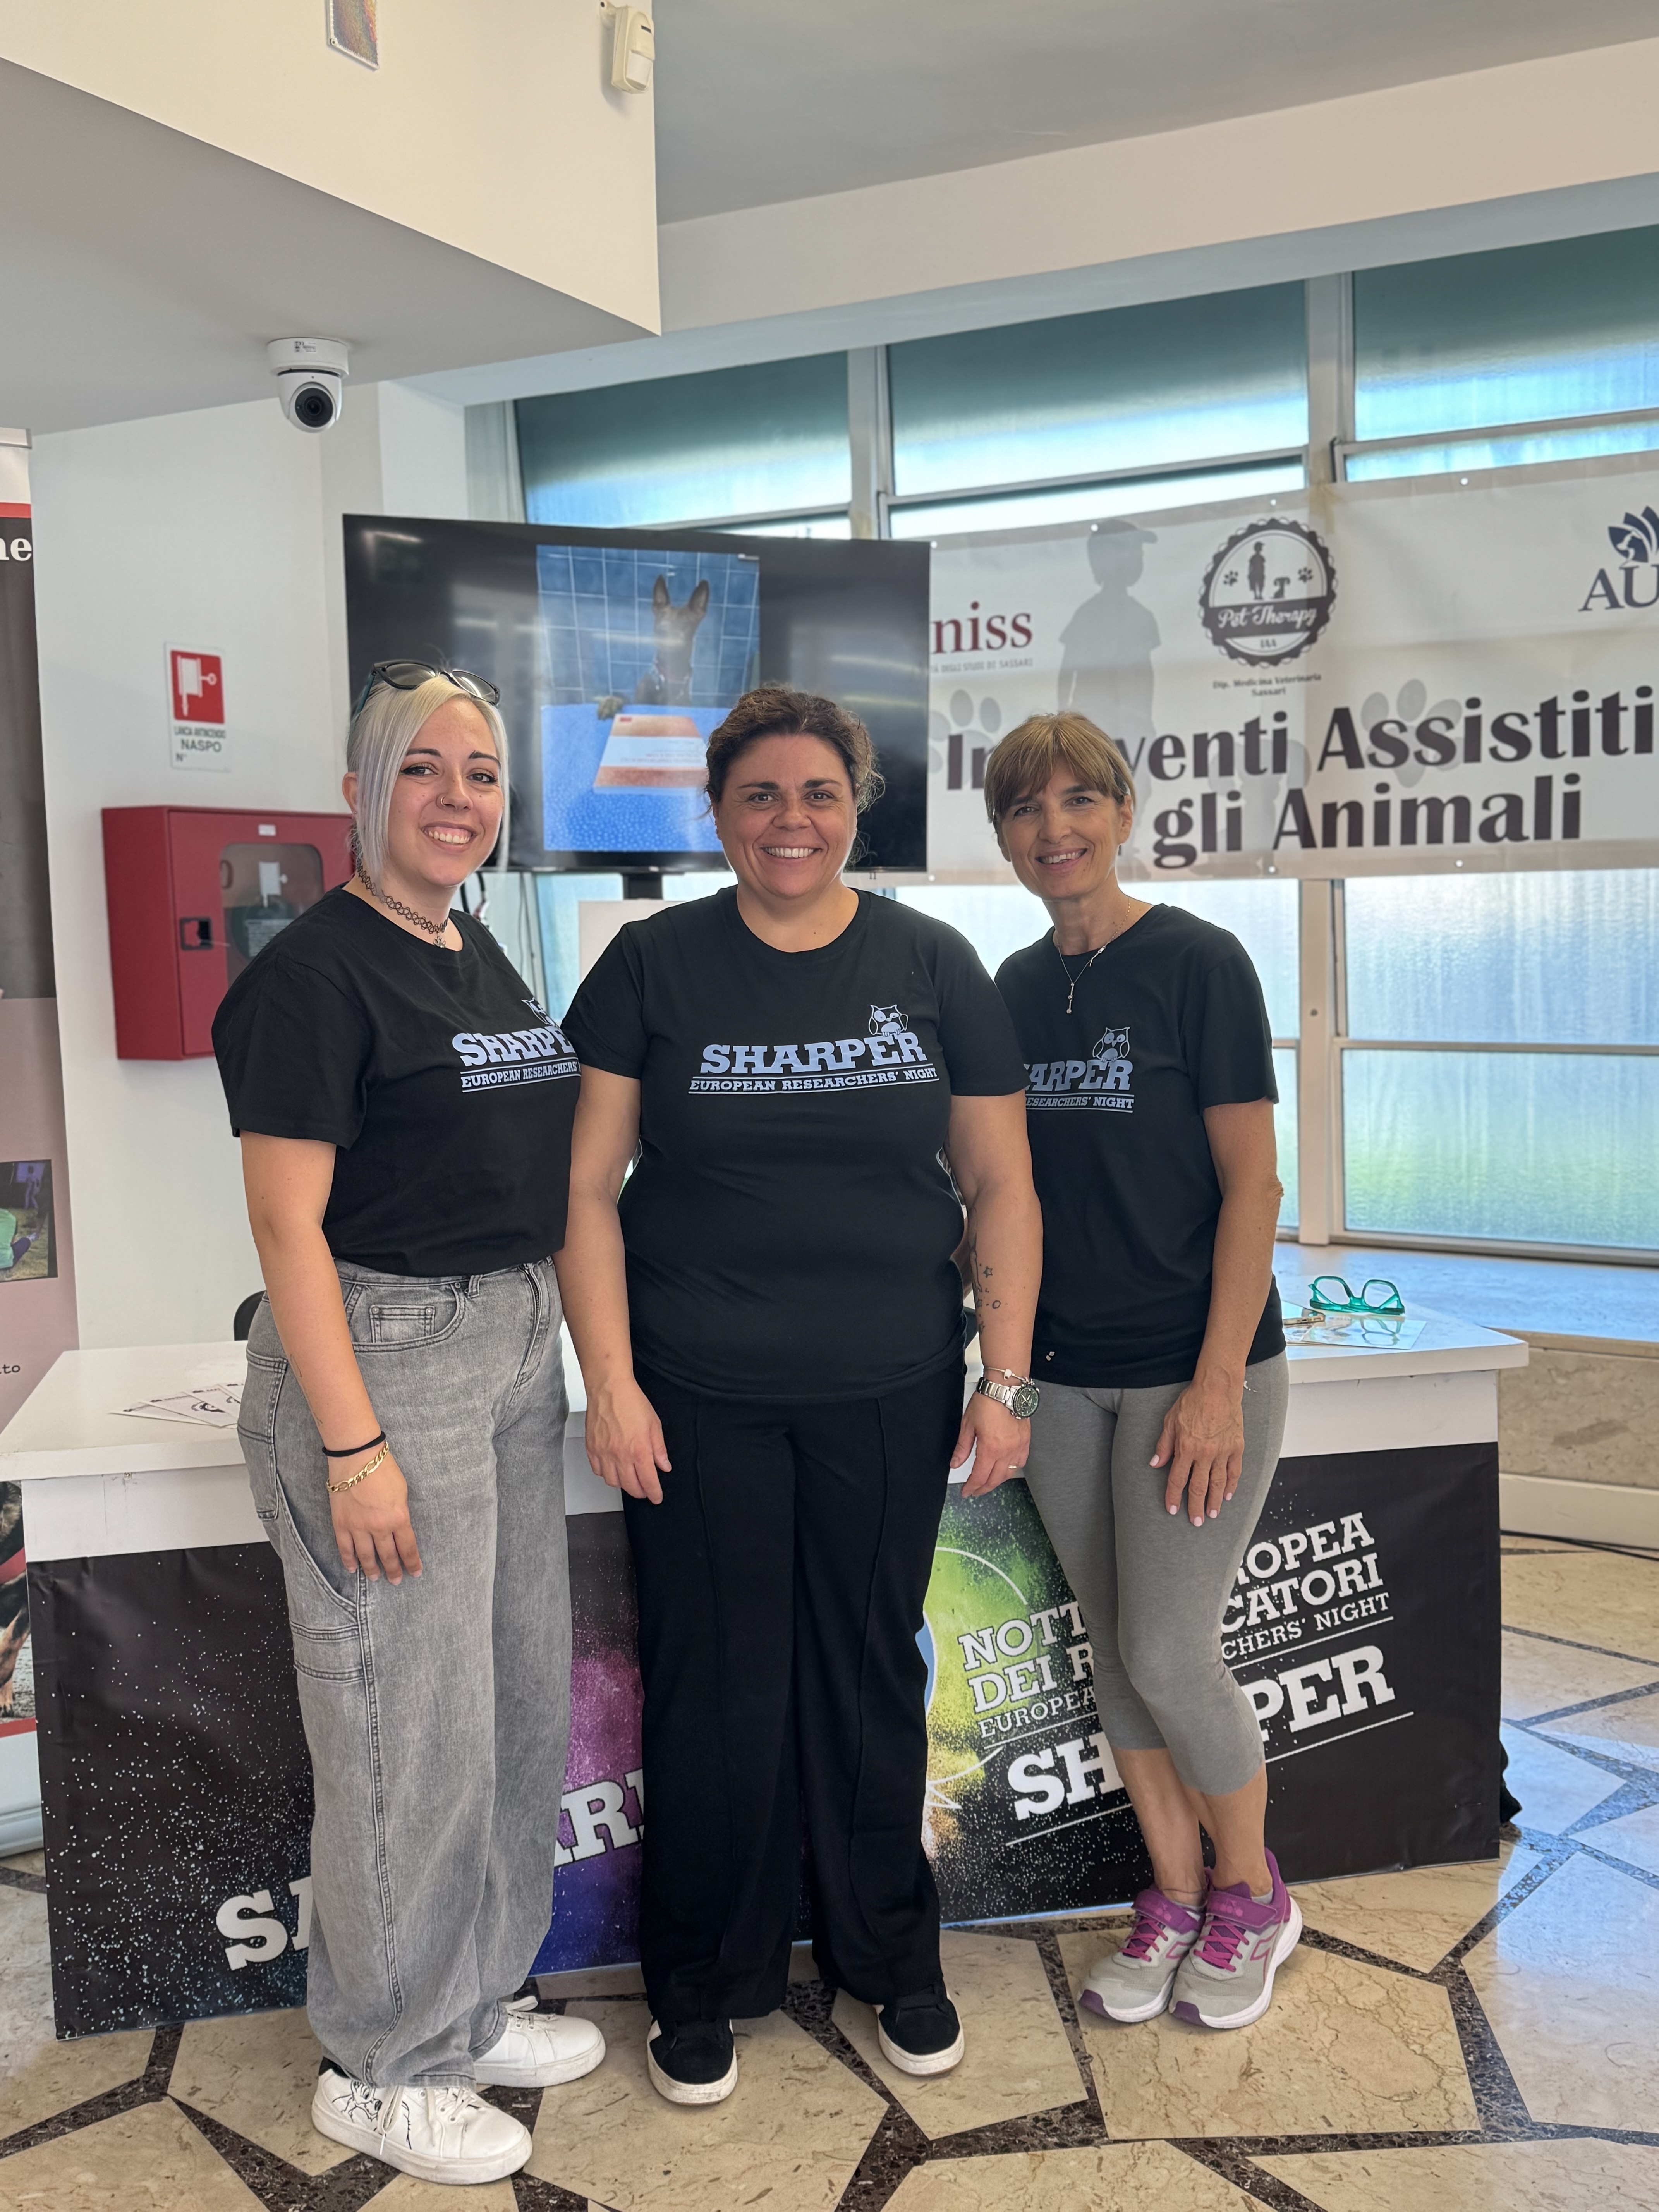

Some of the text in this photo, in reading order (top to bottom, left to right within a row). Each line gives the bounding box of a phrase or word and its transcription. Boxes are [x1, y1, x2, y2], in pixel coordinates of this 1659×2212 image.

[1252, 605, 1317, 629] Therapy
[1318, 685, 1654, 771] Assistiti
[181, 739, 222, 752] NASPO
[1153, 773, 1580, 869] gli Animali
[700, 1032, 927, 1074] SHARPER
[461, 1071, 520, 1087] EUROPEAN
[689, 1068, 937, 1091] EUROPEAN RESEARCHERS' NIGHT
[1024, 1059, 1133, 1091] ARPER
[1025, 1097, 1134, 1109] ESEARCHERS' NIGHT
[1314, 1592, 1389, 1630] NIGHT
[969, 1654, 1058, 1713] DEI
